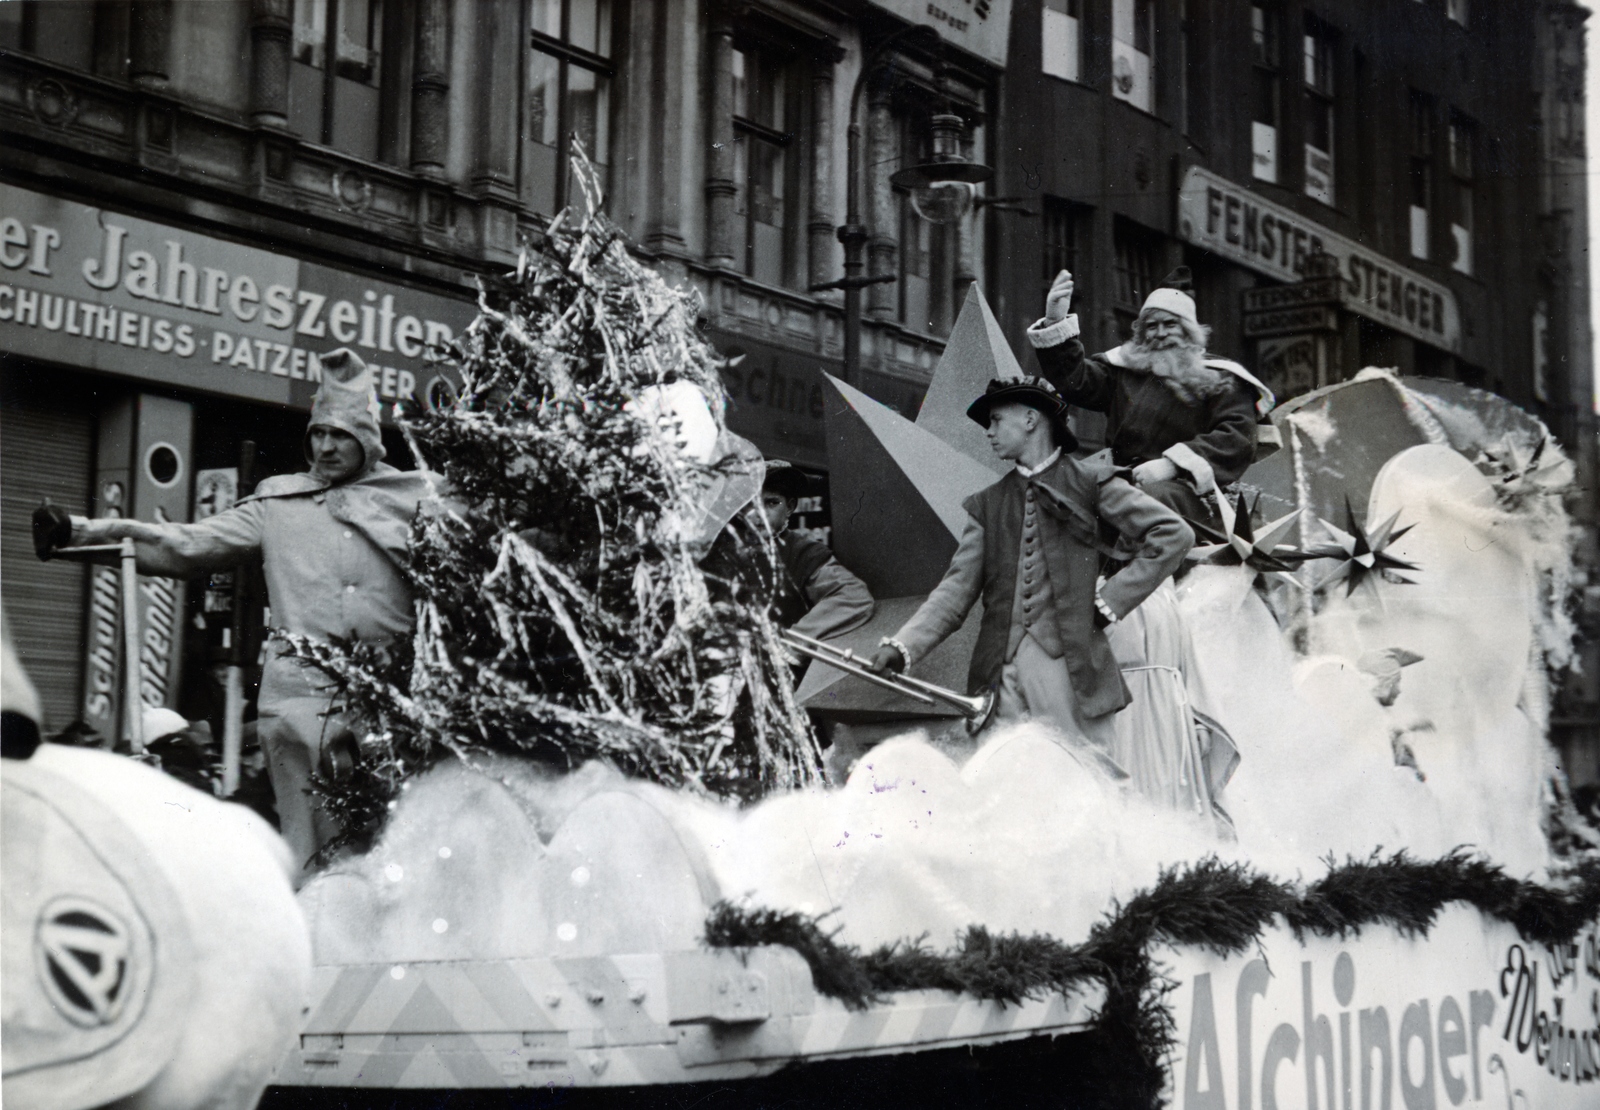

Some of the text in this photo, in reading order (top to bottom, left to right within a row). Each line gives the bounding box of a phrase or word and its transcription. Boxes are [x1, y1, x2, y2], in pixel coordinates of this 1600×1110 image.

[0, 217, 454, 362] er Jahreszeiten
[1350, 253, 1445, 335] STENGER
[211, 331, 416, 400] PATZENFER
